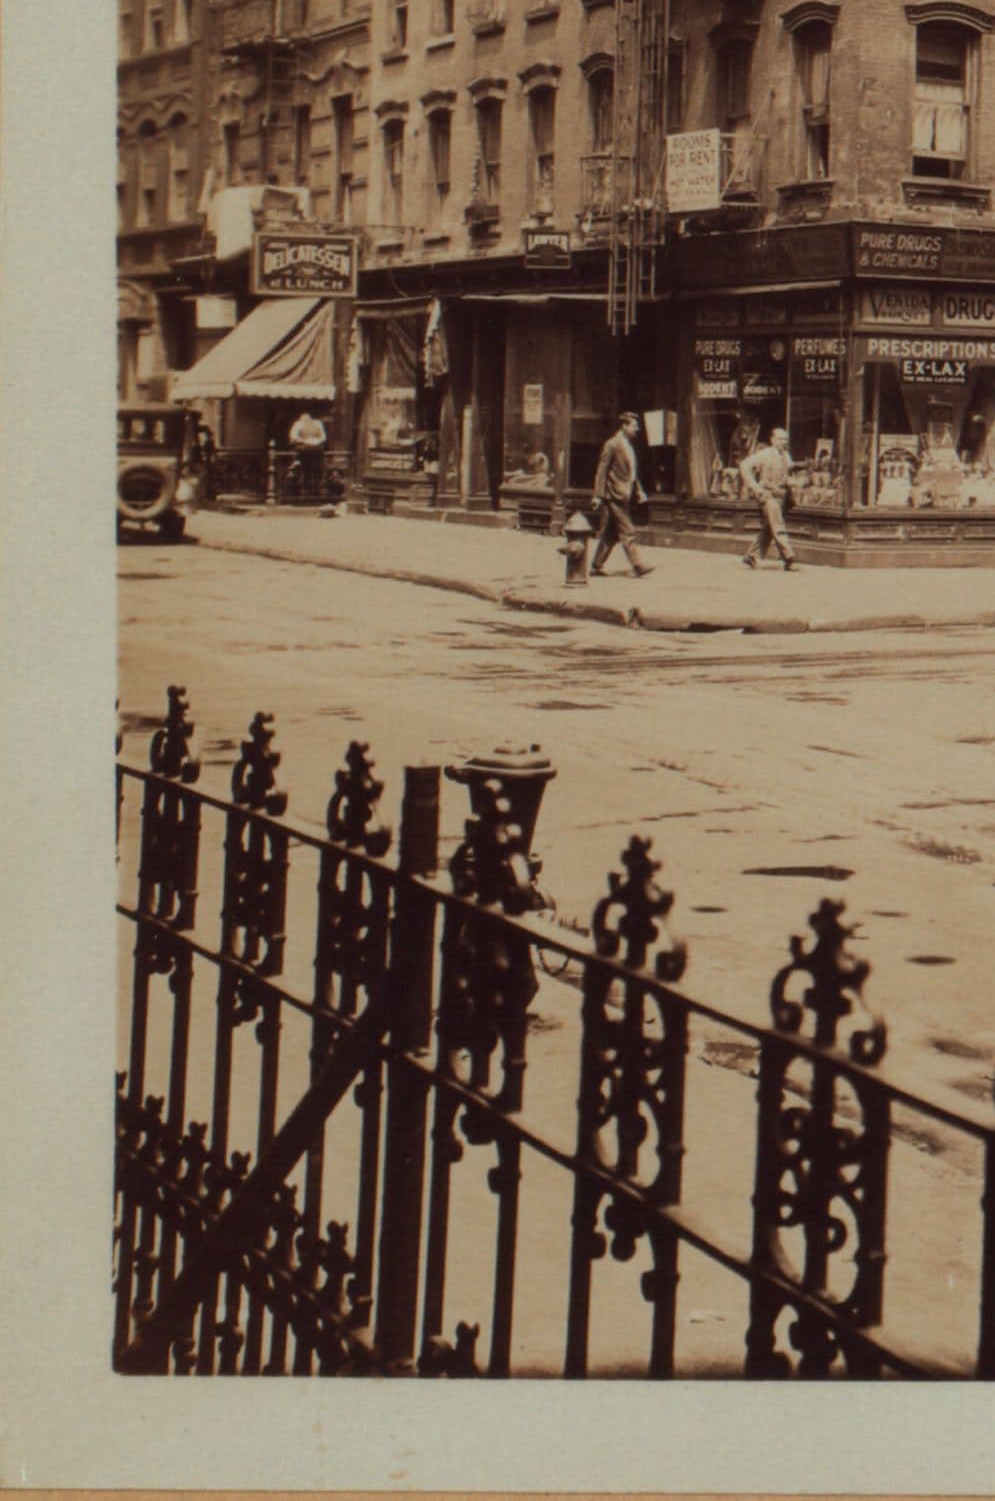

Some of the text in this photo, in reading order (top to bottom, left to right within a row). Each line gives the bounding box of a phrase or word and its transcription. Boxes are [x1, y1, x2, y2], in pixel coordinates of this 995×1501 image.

[672, 134, 711, 150] ROOMS
[689, 149, 716, 166] RENT
[860, 232, 894, 250] PURE
[897, 236, 942, 254] DRUGS
[264, 245, 350, 276] DELICATESSEN
[860, 253, 938, 270] & CHEMICALS
[286, 279, 343, 290] LUNCH
[795, 338, 846, 356] PERFUMES
[805, 358, 836, 373] EX-LAX
[904, 360, 966, 377] EX-LAX
